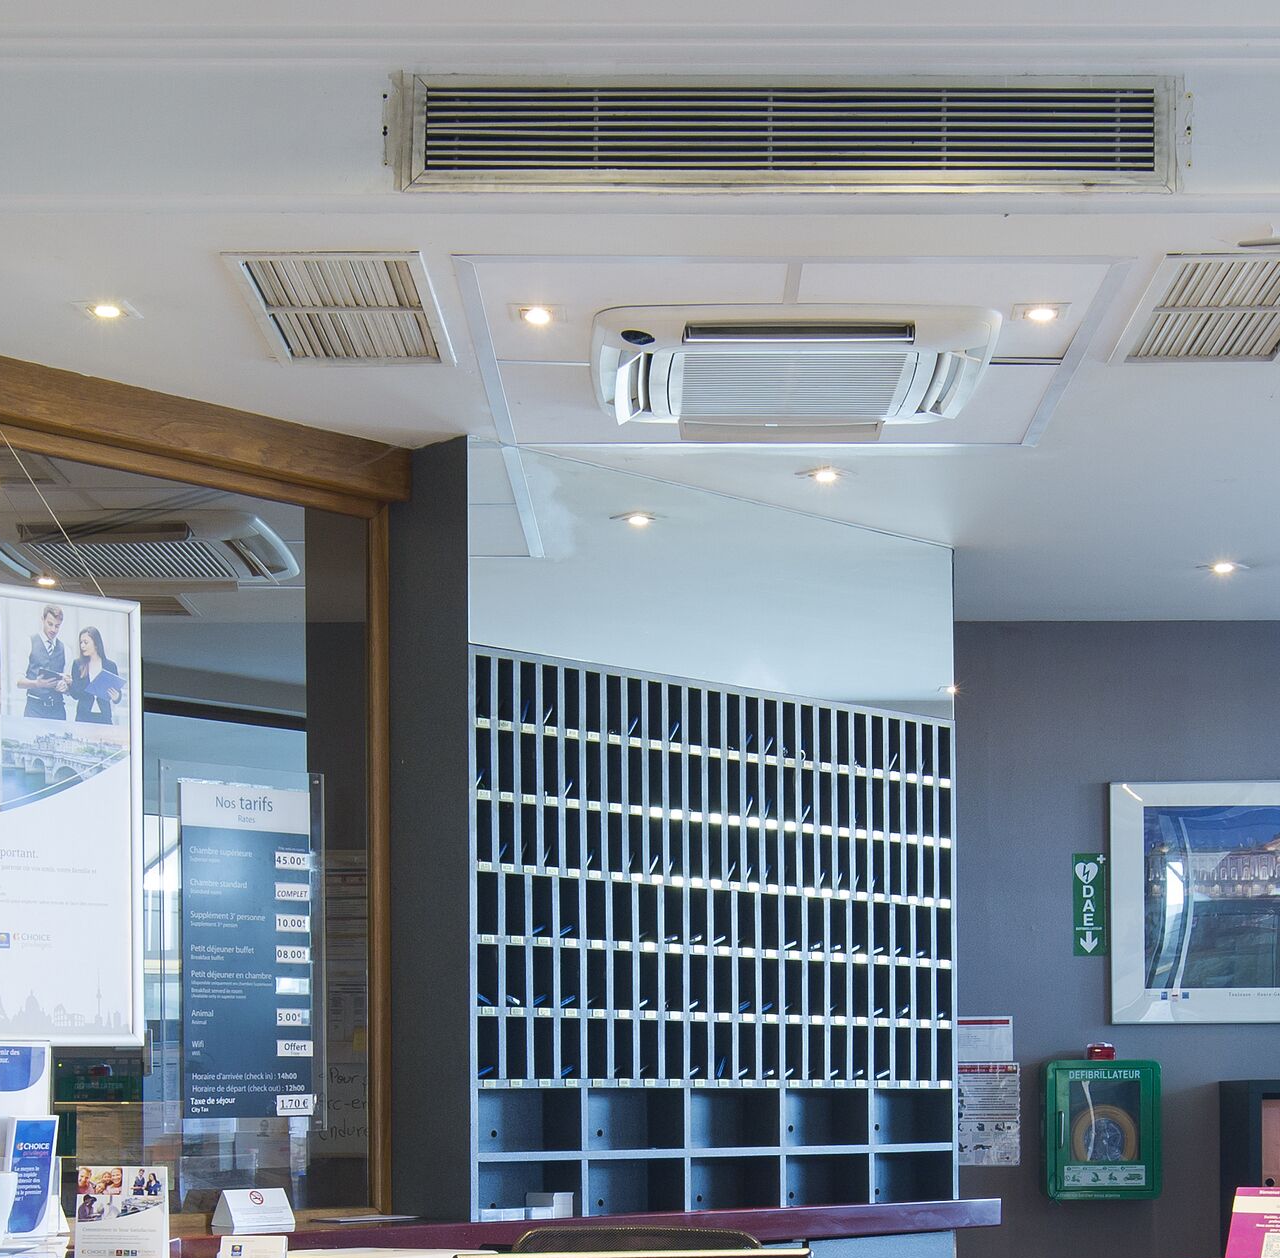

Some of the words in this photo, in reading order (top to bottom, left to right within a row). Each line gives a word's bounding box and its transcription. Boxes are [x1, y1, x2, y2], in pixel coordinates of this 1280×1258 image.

[215, 796, 236, 809] Nos
[240, 796, 273, 812] tarifs
[237, 815, 256, 823] Rates
[189, 846, 218, 855] Chambre
[190, 879, 219, 888] Chambre
[220, 880, 247, 889] standard
[277, 889, 308, 898] COMPLET
[1082, 885, 1095, 926] DAE
[190, 910, 229, 922] Supplément
[237, 914, 266, 923] personne
[22, 932, 51, 941] CHOICE
[190, 944, 206, 952] Petit
[207, 945, 234, 954] déjeuner
[235, 946, 254, 954] buffet
[190, 970, 206, 978] Petit
[207, 970, 234, 980] déjeuner
[244, 971, 272, 980] chambre
[191, 1009, 214, 1018] Animal
[191, 1040, 205, 1048] Wifi
[284, 1043, 307, 1051] Offert
[192, 1072, 215, 1080] Horaire
[216, 1072, 243, 1080] d'arrivée
[244, 1072, 263, 1081] (check
[264, 1072, 273, 1081] in)
[1069, 1070, 1140, 1079] DEFIBRILLATEUR
[192, 1084, 214, 1092] Horaire
[215, 1084, 224, 1092] de
[225, 1084, 246, 1094] départ
[247, 1084, 267, 1093] (check
[268, 1084, 281, 1093] out)
[191, 1097, 205, 1105] Taxe
[207, 1097, 214, 1105] de
[215, 1097, 236, 1105] séjour
[280, 1099, 300, 1110] 1.70
